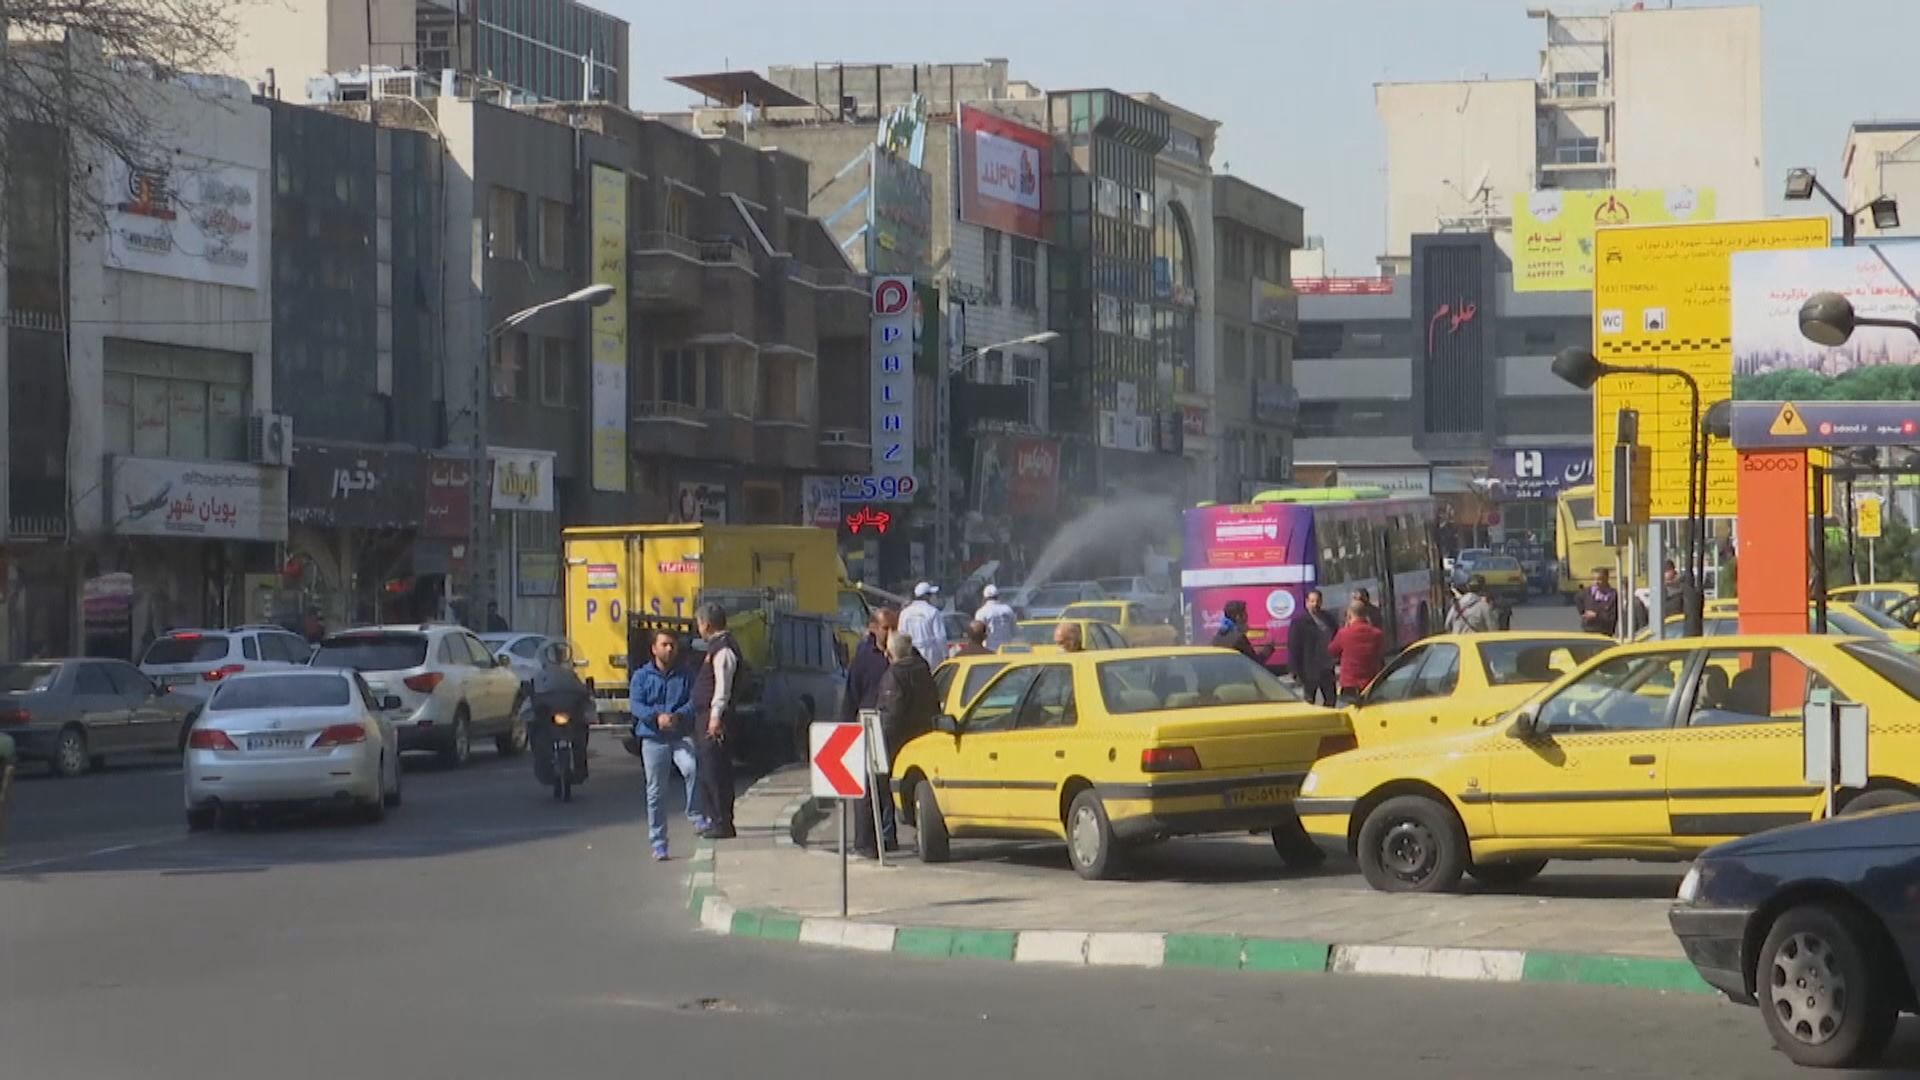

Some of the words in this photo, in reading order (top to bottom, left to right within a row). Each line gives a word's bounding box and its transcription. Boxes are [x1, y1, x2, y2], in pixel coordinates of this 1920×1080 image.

[1603, 315, 1621, 328] WC
[166, 491, 195, 521] شهر
[199, 496, 237, 528] پویان
[846, 506, 891, 534] چاپ
[586, 597, 685, 623] POST
